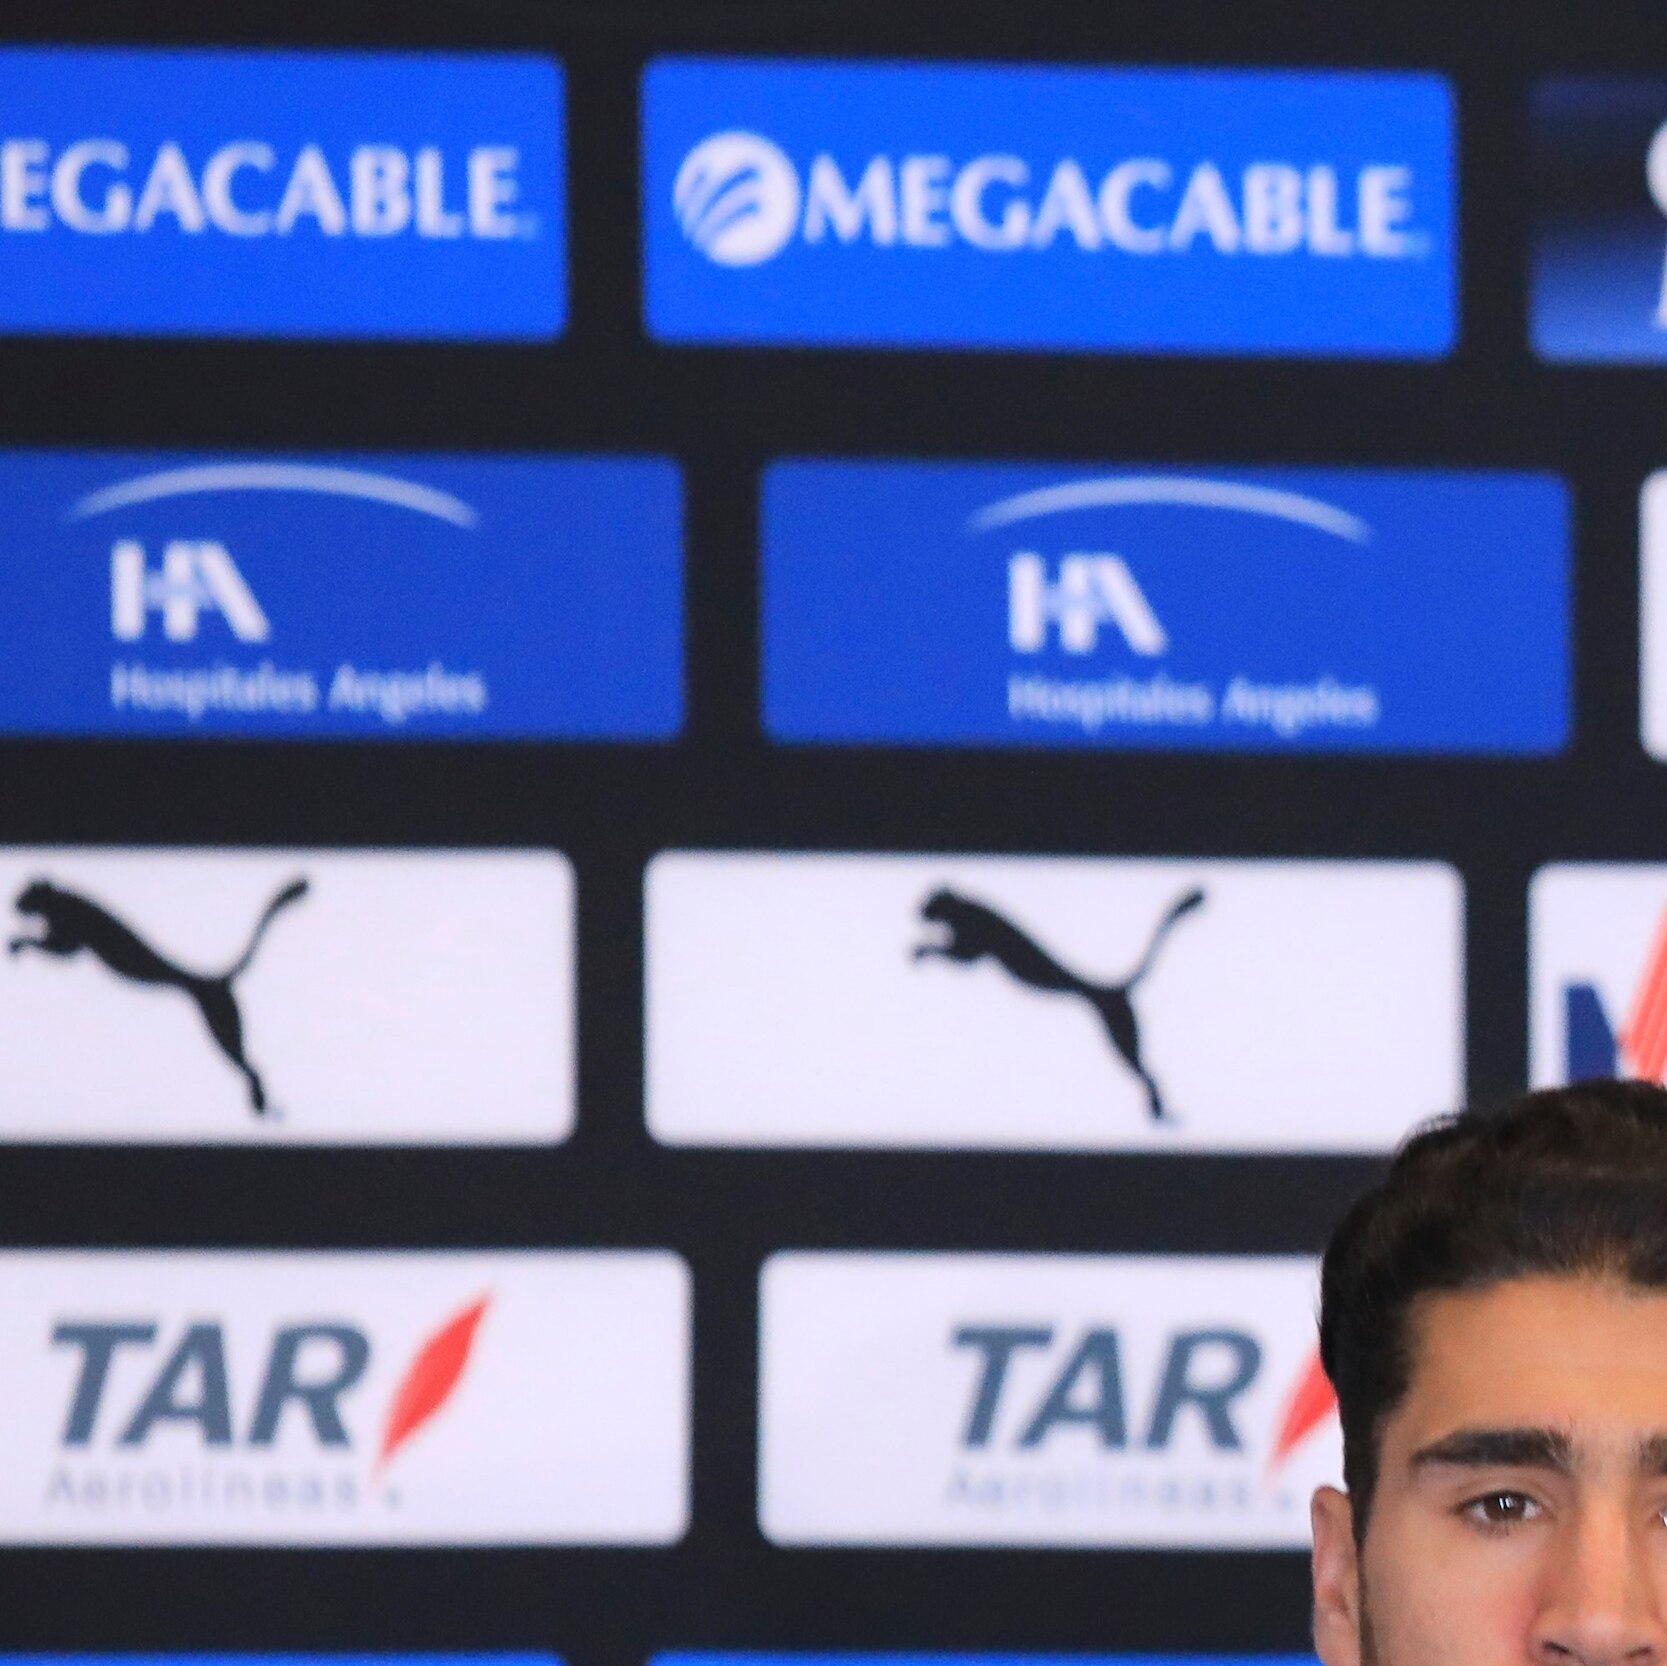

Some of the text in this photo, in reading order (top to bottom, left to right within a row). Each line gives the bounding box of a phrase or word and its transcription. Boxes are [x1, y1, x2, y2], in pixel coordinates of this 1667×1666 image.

[803, 152, 1413, 258] MEGACABLE
[52, 1320, 372, 1449] TAR
[953, 1324, 1263, 1453] TAR
